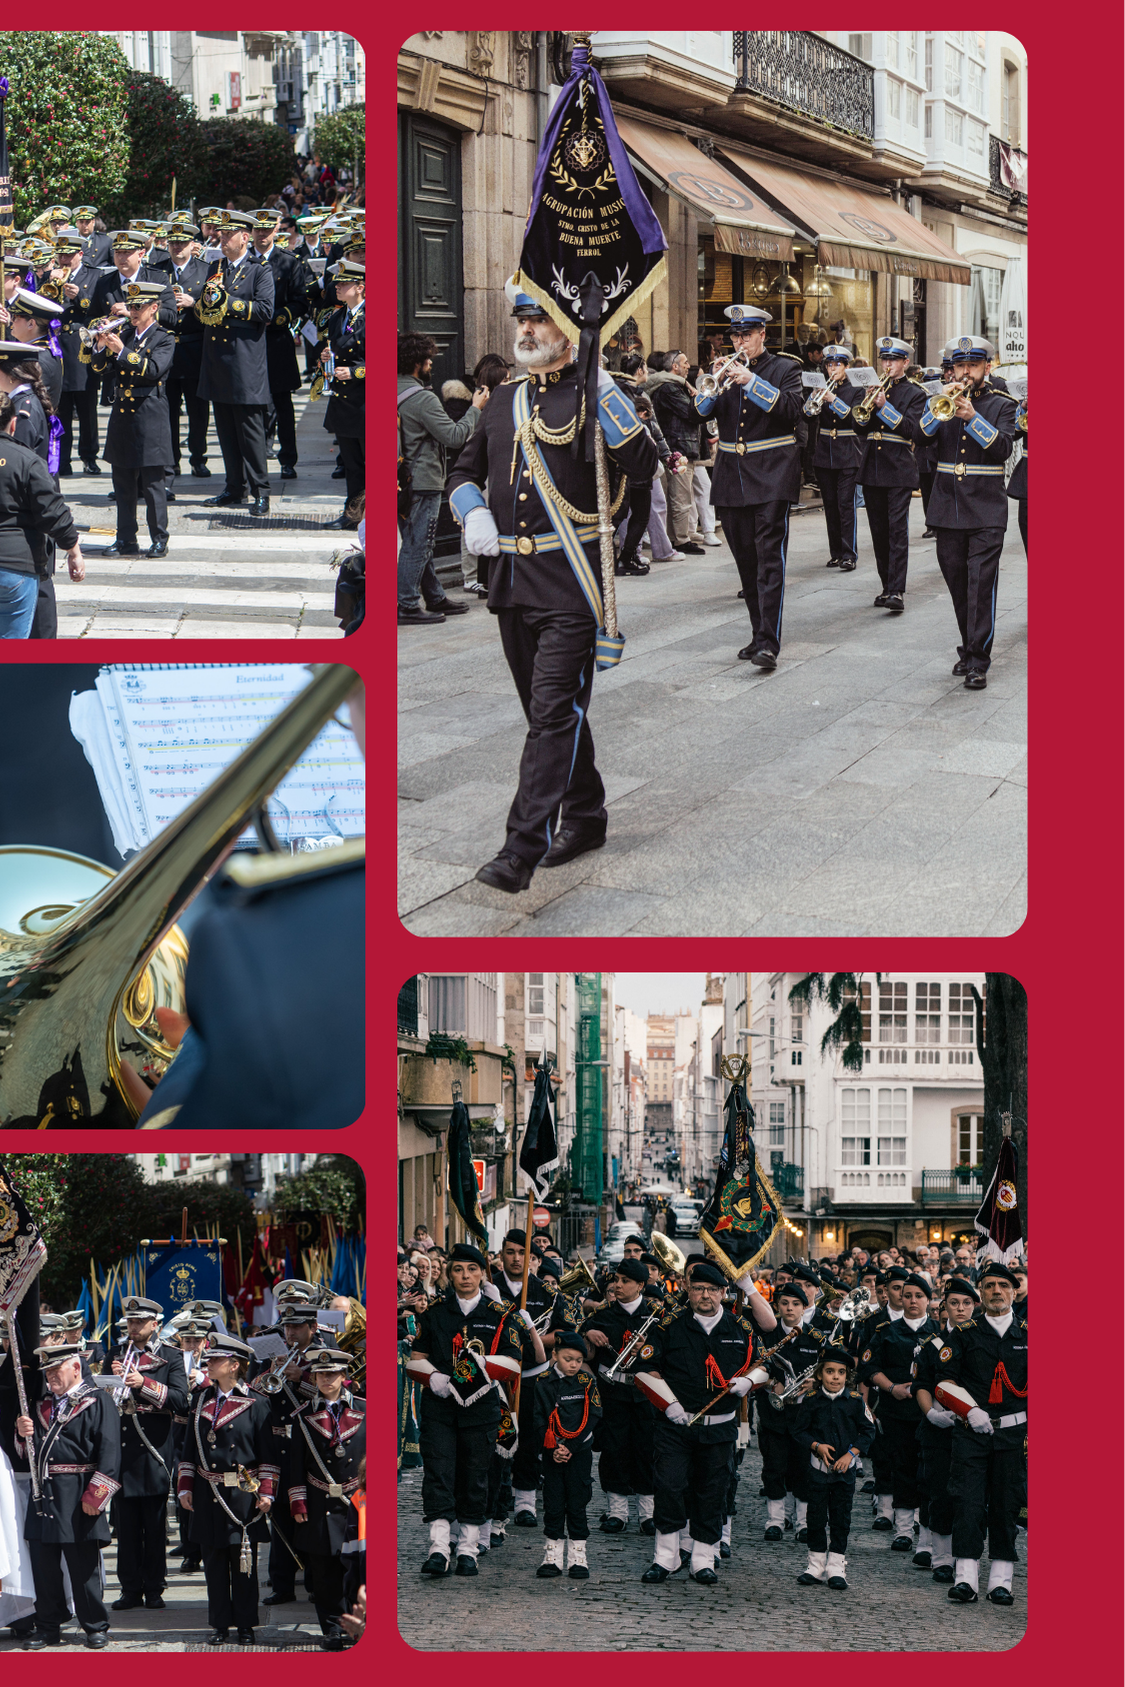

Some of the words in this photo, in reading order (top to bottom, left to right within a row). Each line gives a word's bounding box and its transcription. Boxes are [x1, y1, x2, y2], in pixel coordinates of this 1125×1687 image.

[542, 193, 594, 219] AGRUPACIÓN
[577, 224, 598, 232] CRISTO
[601, 222, 609, 231] DE
[611, 218, 620, 227] LA
[559, 232, 583, 246] BUENA
[588, 230, 621, 246] MUERTE
[577, 249, 602, 257] FERROL
[236, 673, 284, 683] Eternidad
